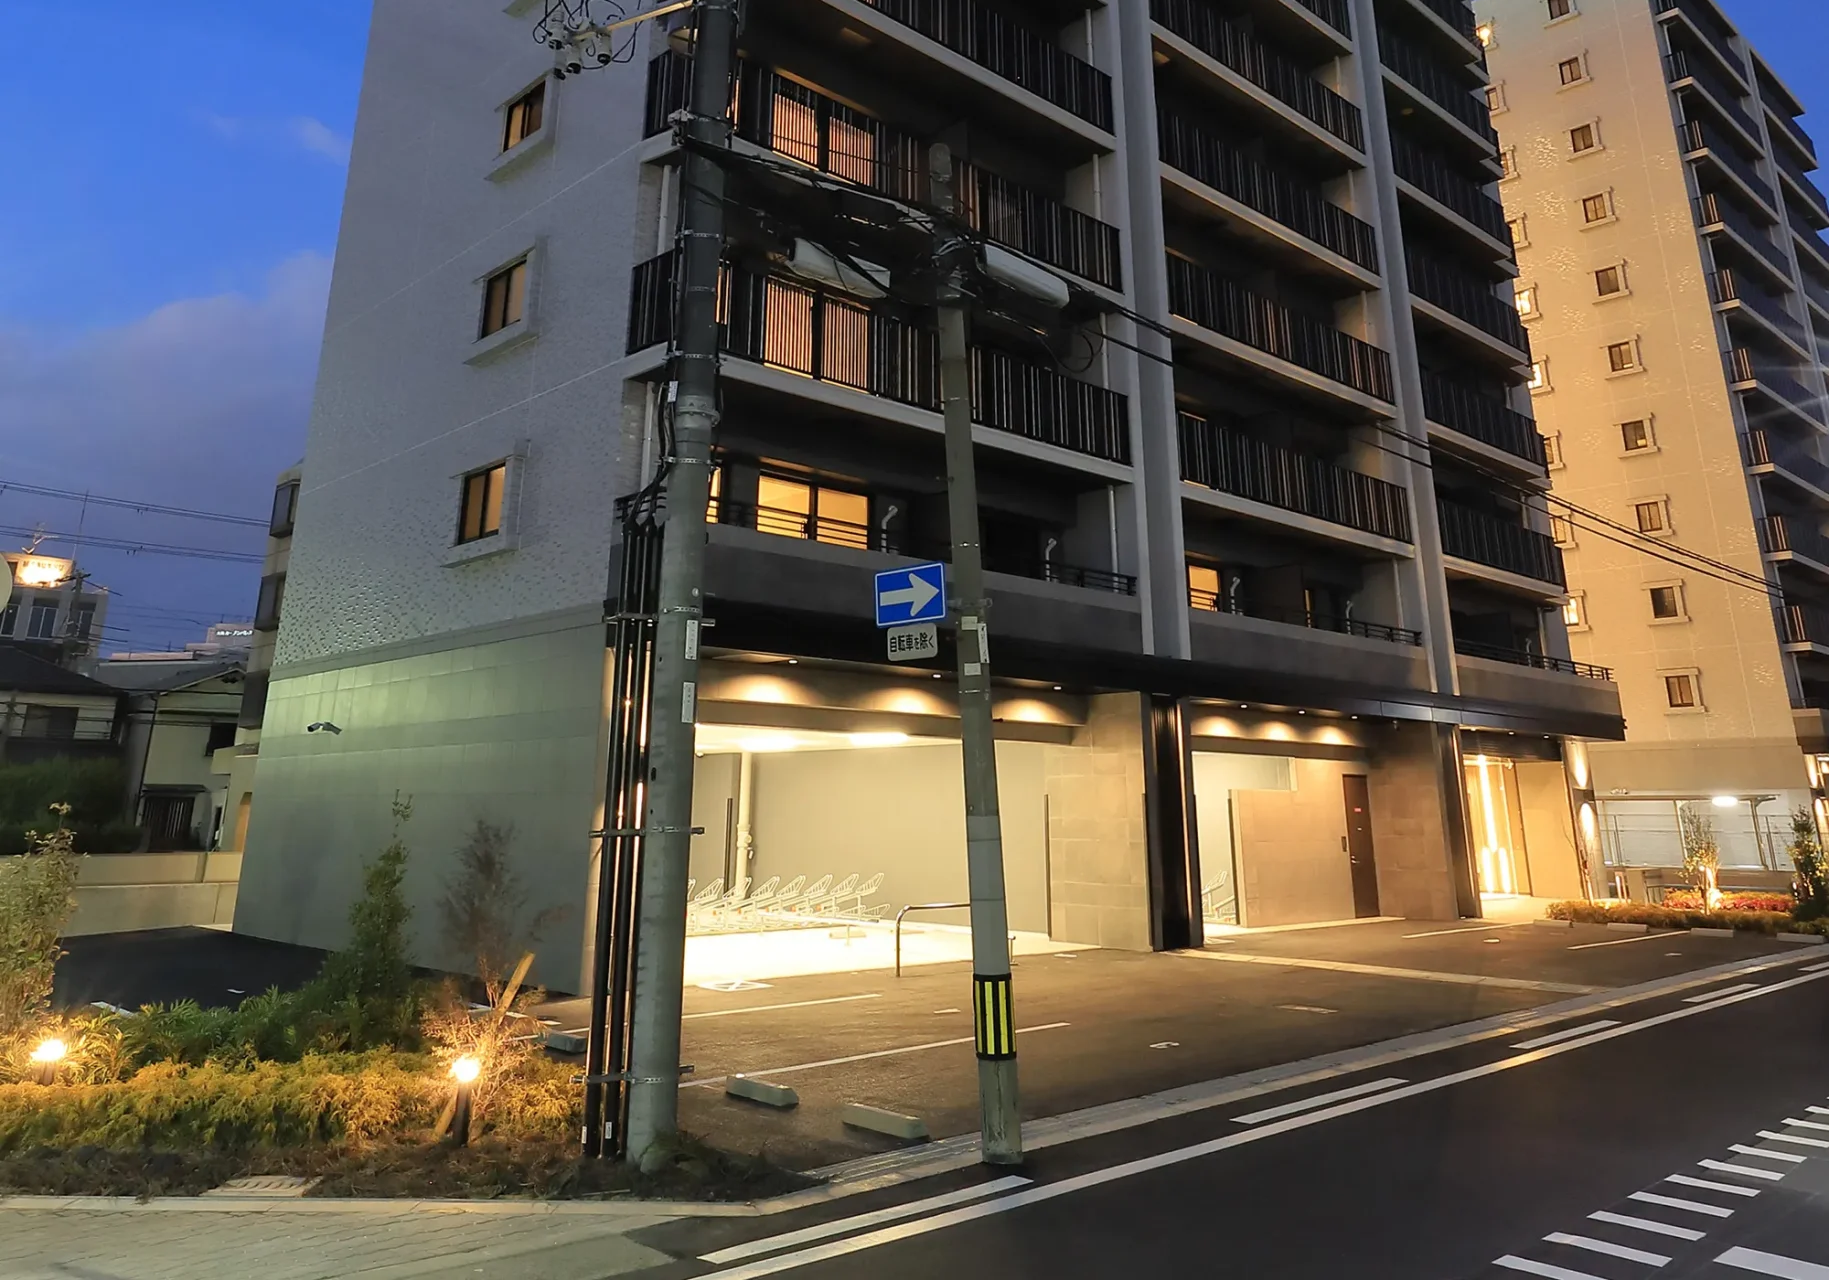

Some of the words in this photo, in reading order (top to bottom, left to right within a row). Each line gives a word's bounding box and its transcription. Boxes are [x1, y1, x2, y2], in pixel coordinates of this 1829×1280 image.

[889, 631, 934, 653] 自転車を除く
